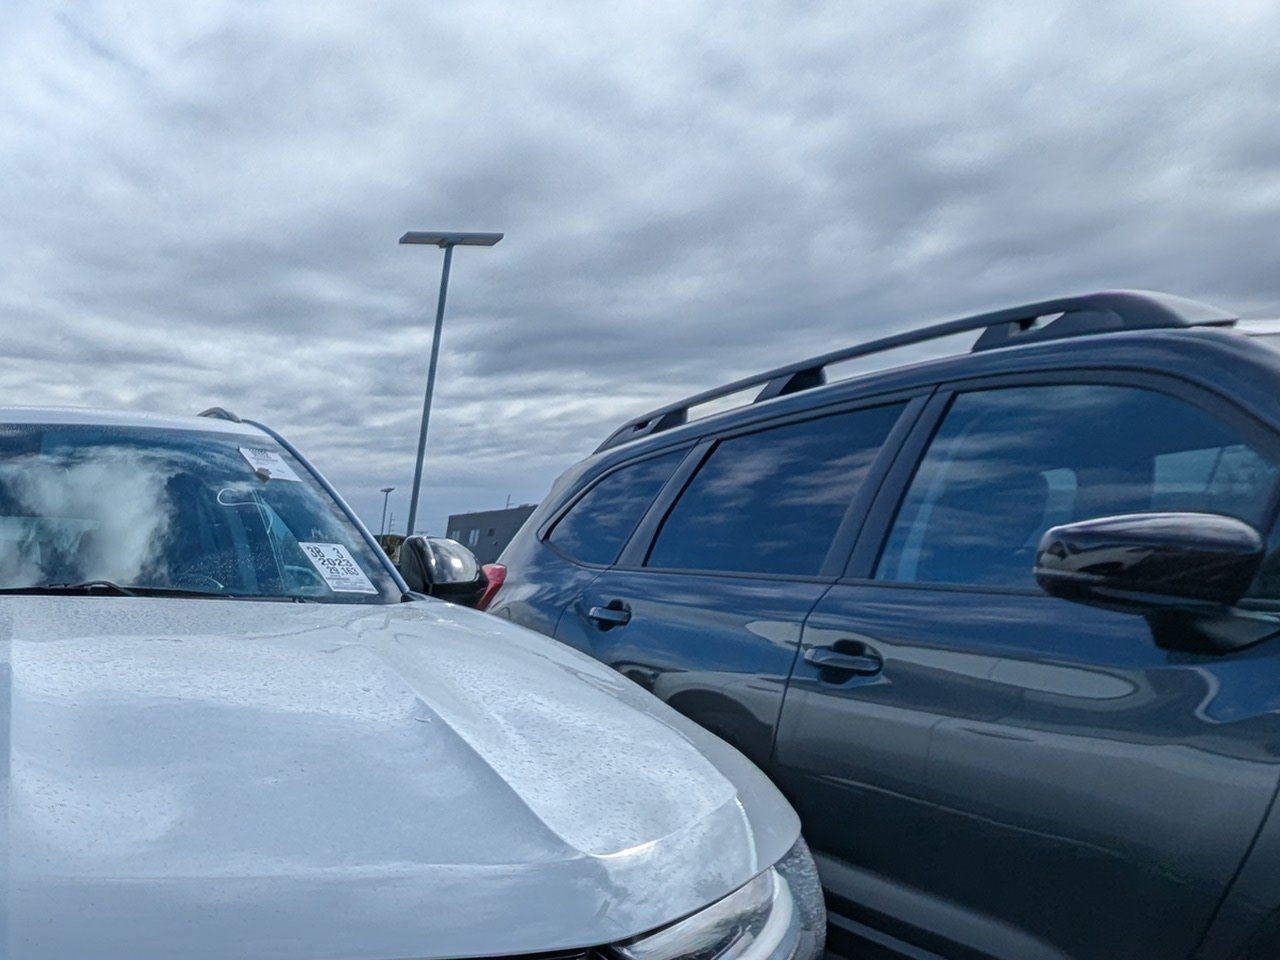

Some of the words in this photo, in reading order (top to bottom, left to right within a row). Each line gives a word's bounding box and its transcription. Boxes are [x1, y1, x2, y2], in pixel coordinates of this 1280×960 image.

[307, 546, 325, 558] 3B
[332, 547, 344, 559] 3
[318, 558, 352, 567] 2023
